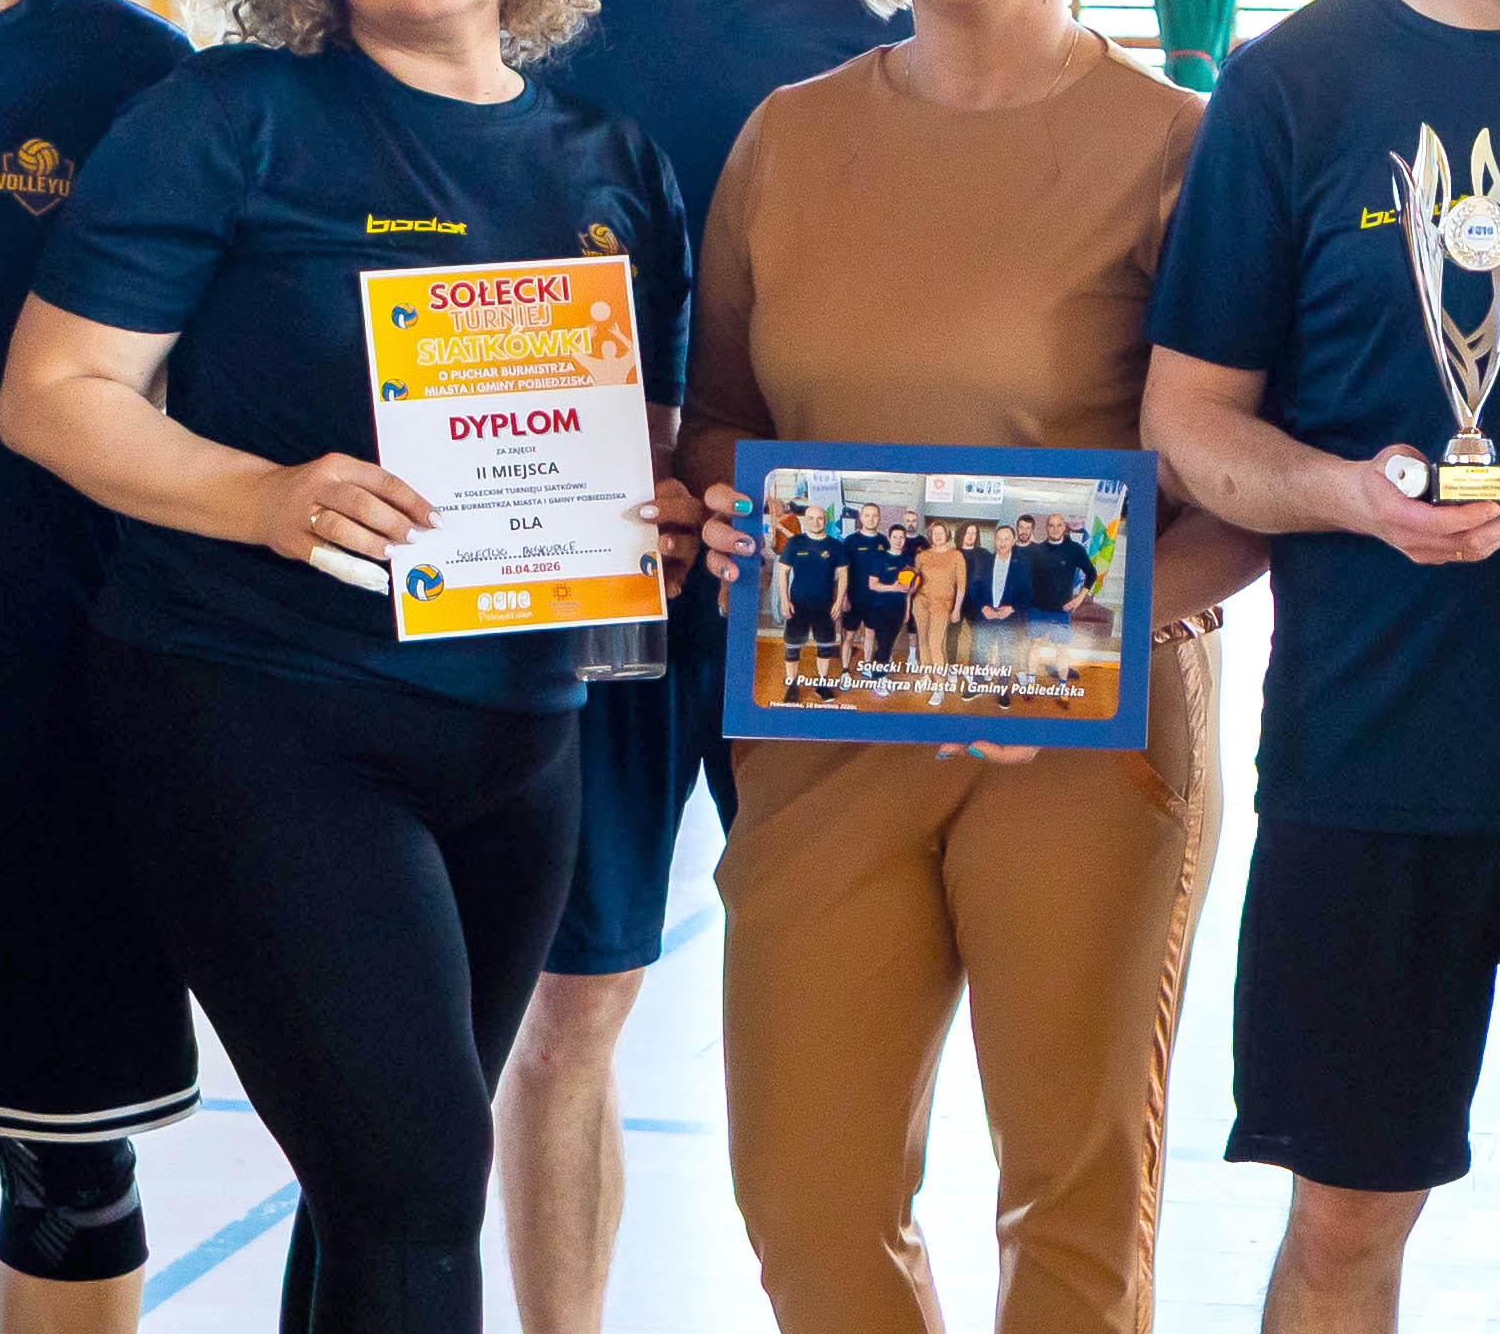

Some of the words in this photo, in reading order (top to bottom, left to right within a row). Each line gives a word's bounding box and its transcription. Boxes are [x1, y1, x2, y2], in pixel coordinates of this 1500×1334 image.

[429, 274, 571, 310] SOŁECKI
[450, 305, 553, 332] TURNIEJ
[417, 327, 593, 365] SIATKÓWKI
[439, 371, 448, 381] O
[451, 367, 499, 381] PUCHAR
[501, 361, 575, 377] BURMISTRZA
[425, 381, 469, 396] MIASTA
[477, 378, 514, 393] GMINY
[518, 375, 595, 390] POBIEDZISKA
[449, 408, 581, 440] DYPLOM
[476, 467, 487, 479] II
[492, 462, 560, 480] MIEJSCA
[505, 485, 542, 495] TURNIEJU
[461, 500, 512, 511] BURMISTRZA
[513, 497, 543, 507] MIASTA
[577, 492, 627, 502] POBIEDZISKA
[510, 516, 543, 531] DLA
[905, 662, 948, 676] Turniej
[950, 663, 1012, 677] Siatkówki
[797, 675, 840, 687] Puchar
[843, 677, 911, 691] Burmistrza
[914, 680, 957, 693] Miasta
[967, 682, 1009, 696] Gminy
[1011, 683, 1085, 697] Pobiedziska
